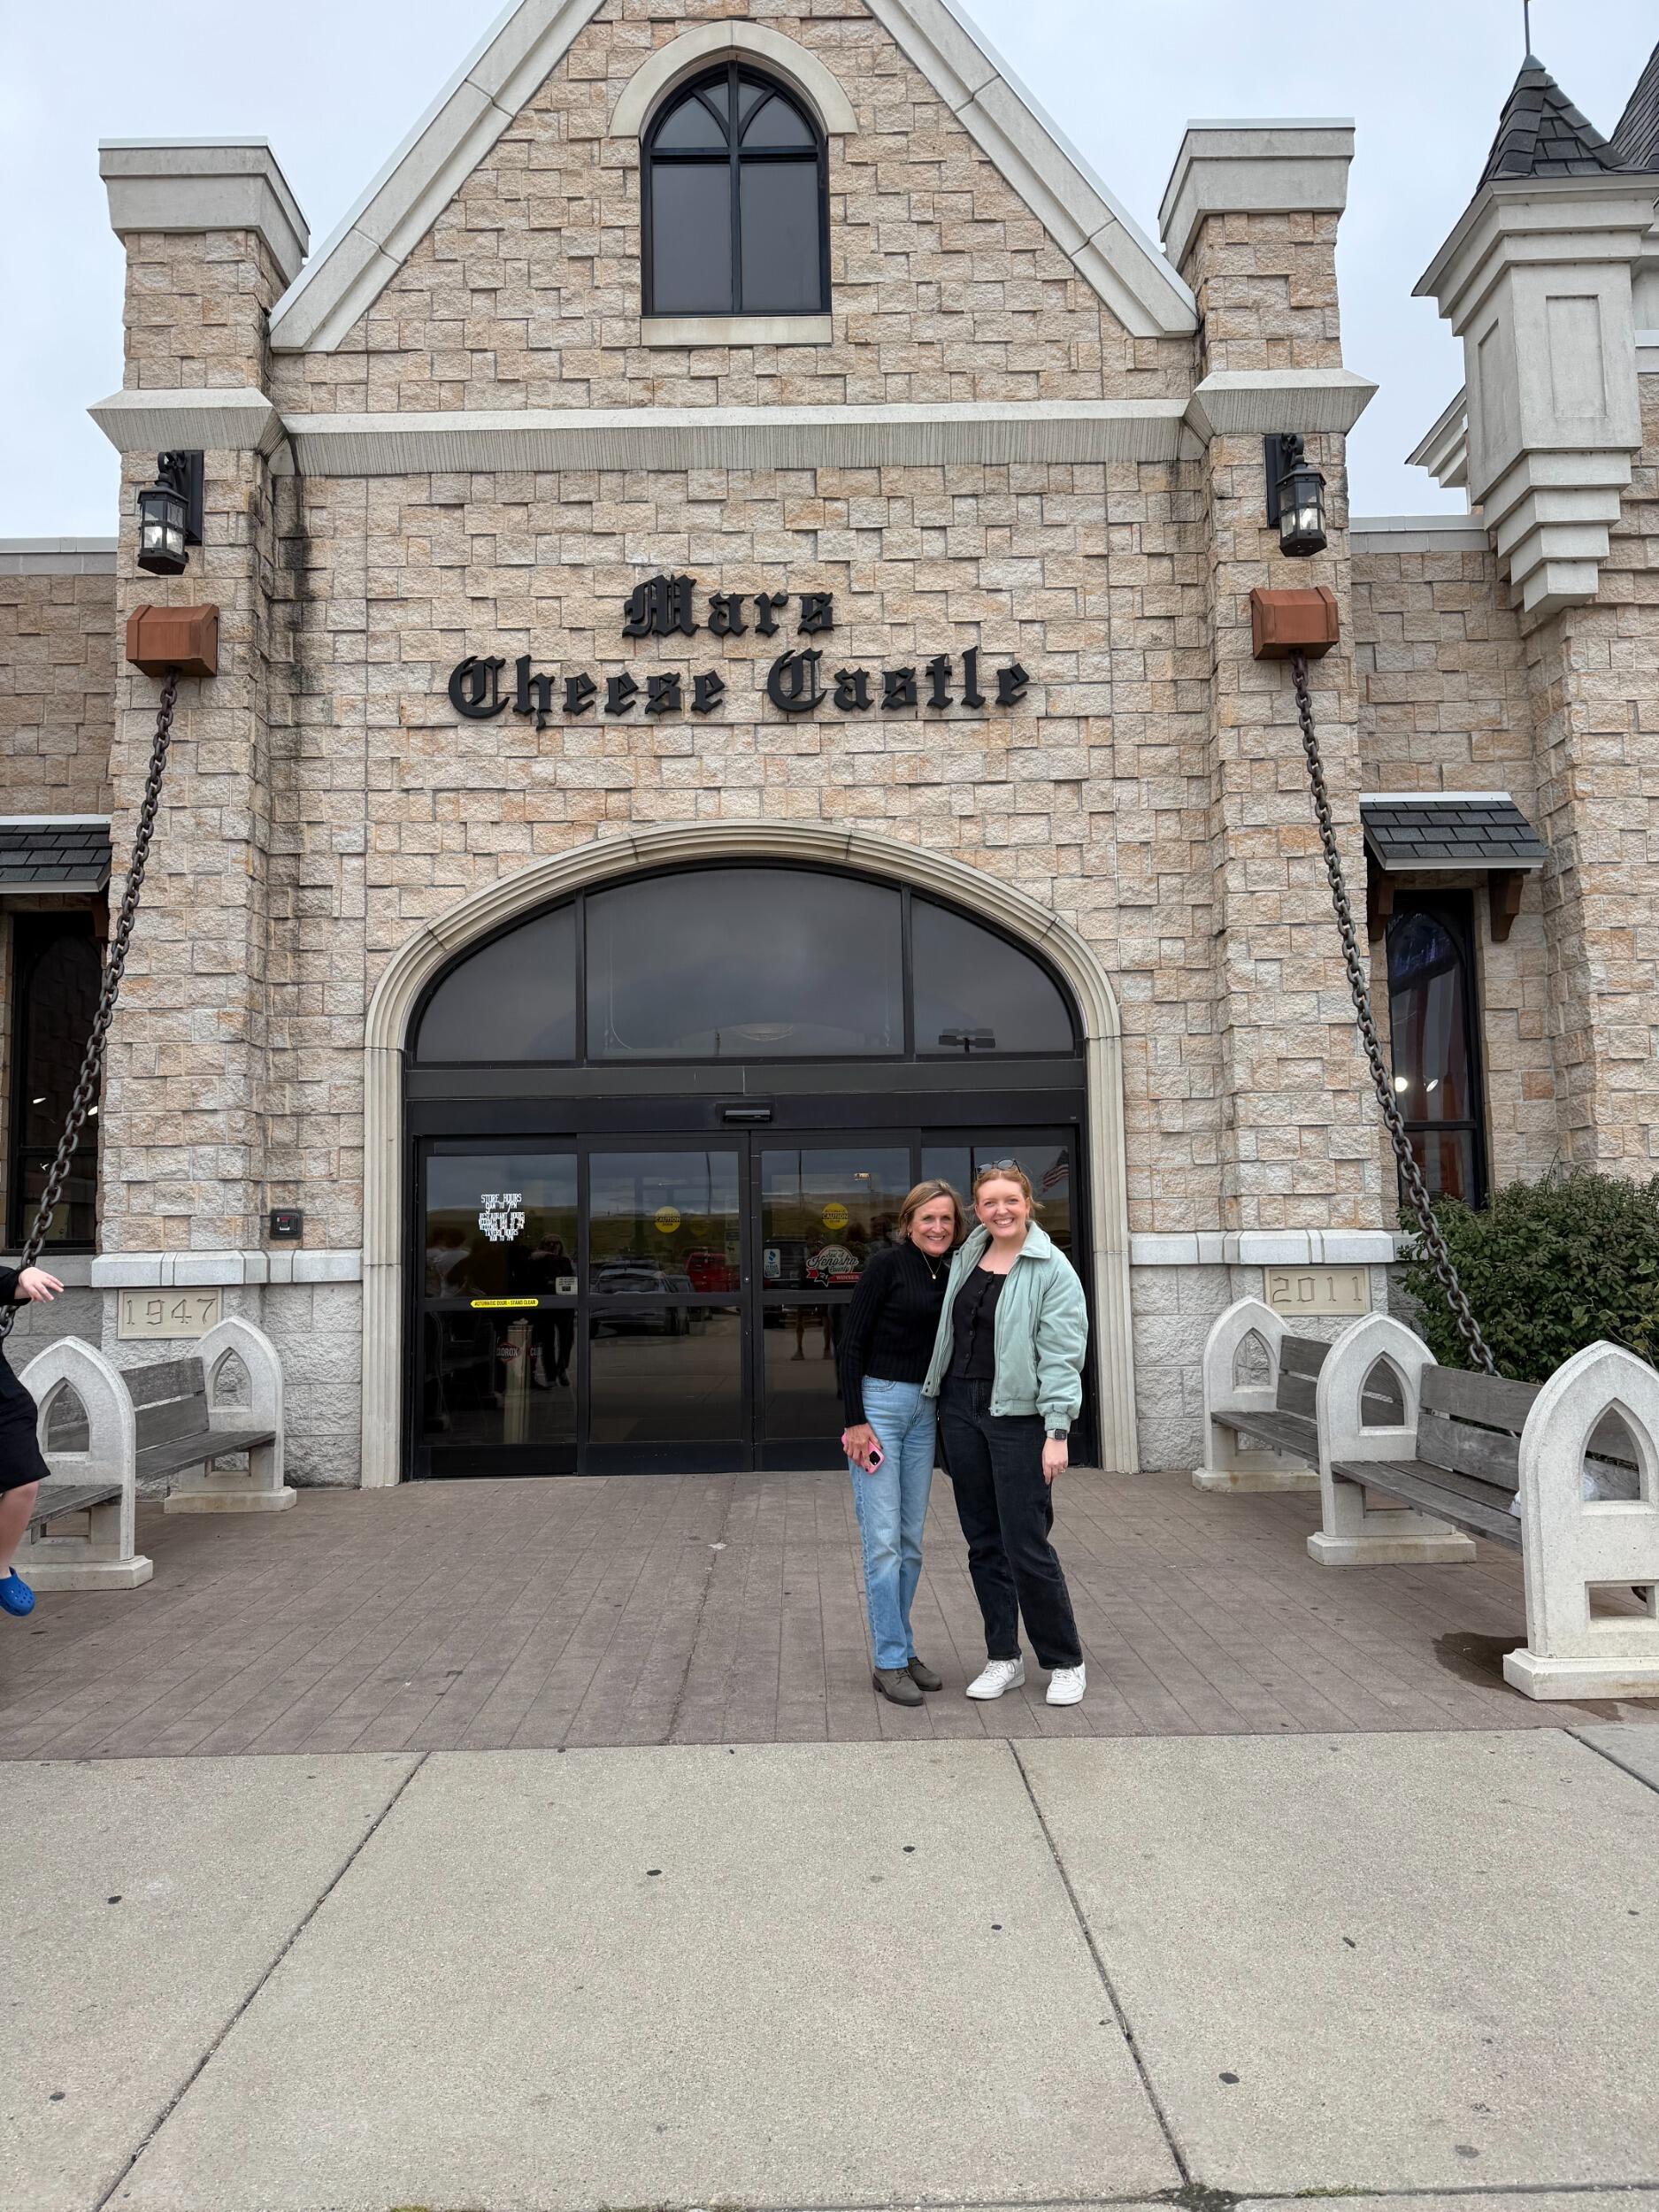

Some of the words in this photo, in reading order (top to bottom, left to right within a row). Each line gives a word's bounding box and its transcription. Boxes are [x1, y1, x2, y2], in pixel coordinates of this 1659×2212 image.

[621, 573, 834, 639] Mars
[448, 653, 726, 731] Cheese
[767, 645, 1030, 713] Castle
[126, 1297, 216, 1325] 1947
[1272, 1274, 1363, 1303] 2011
